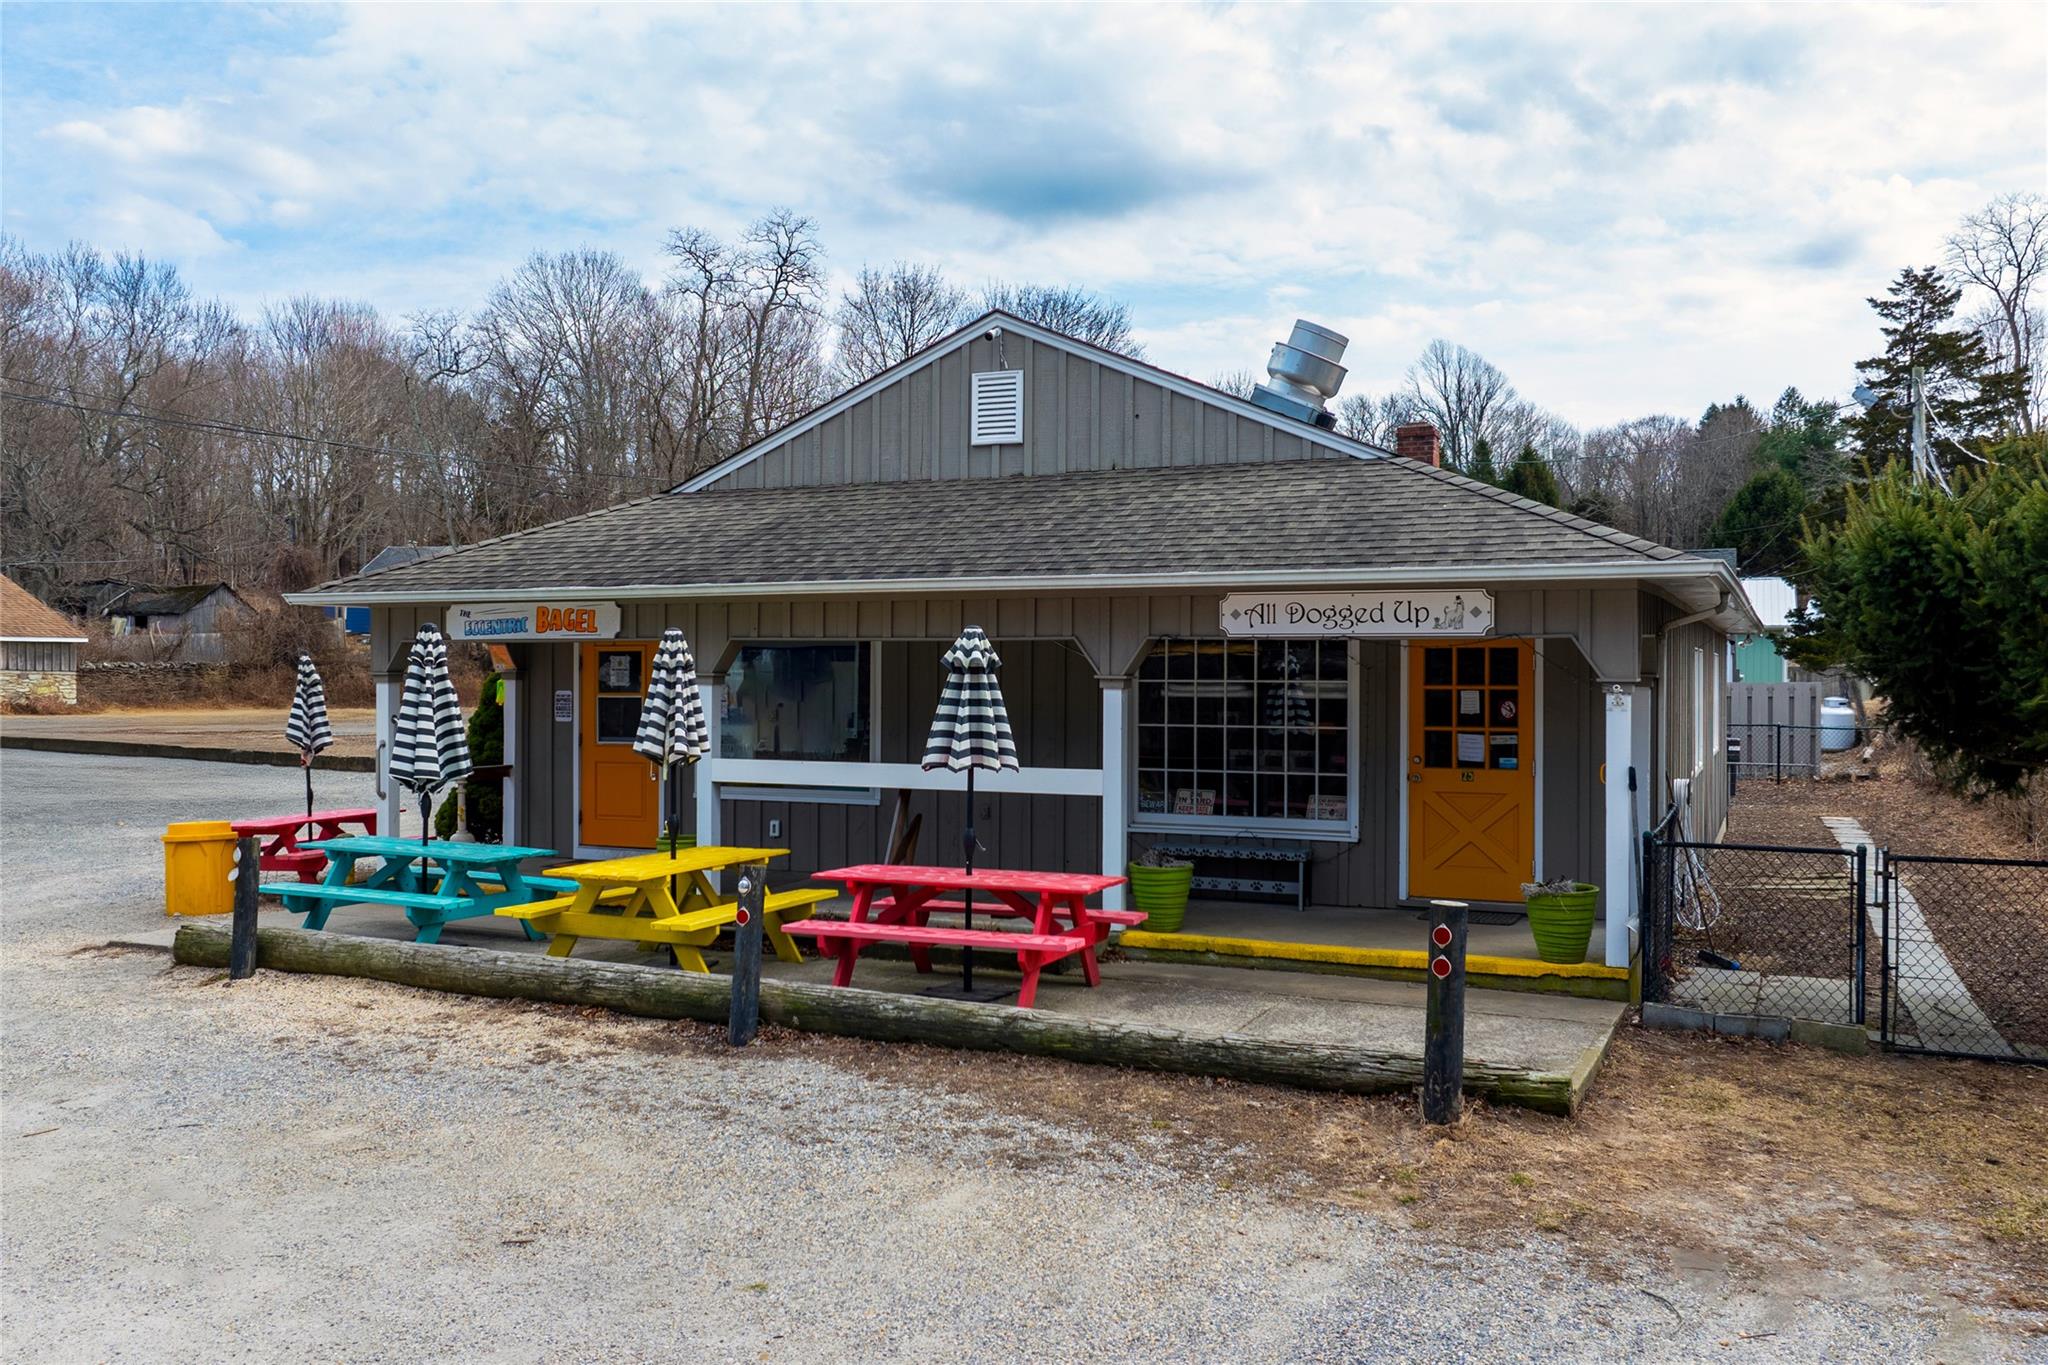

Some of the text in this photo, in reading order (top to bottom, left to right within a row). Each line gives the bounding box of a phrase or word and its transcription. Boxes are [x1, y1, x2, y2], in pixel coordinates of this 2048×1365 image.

[459, 609, 471, 618] THE
[535, 606, 598, 633] BAGEL
[1244, 600, 1430, 630] All Dogged Up
